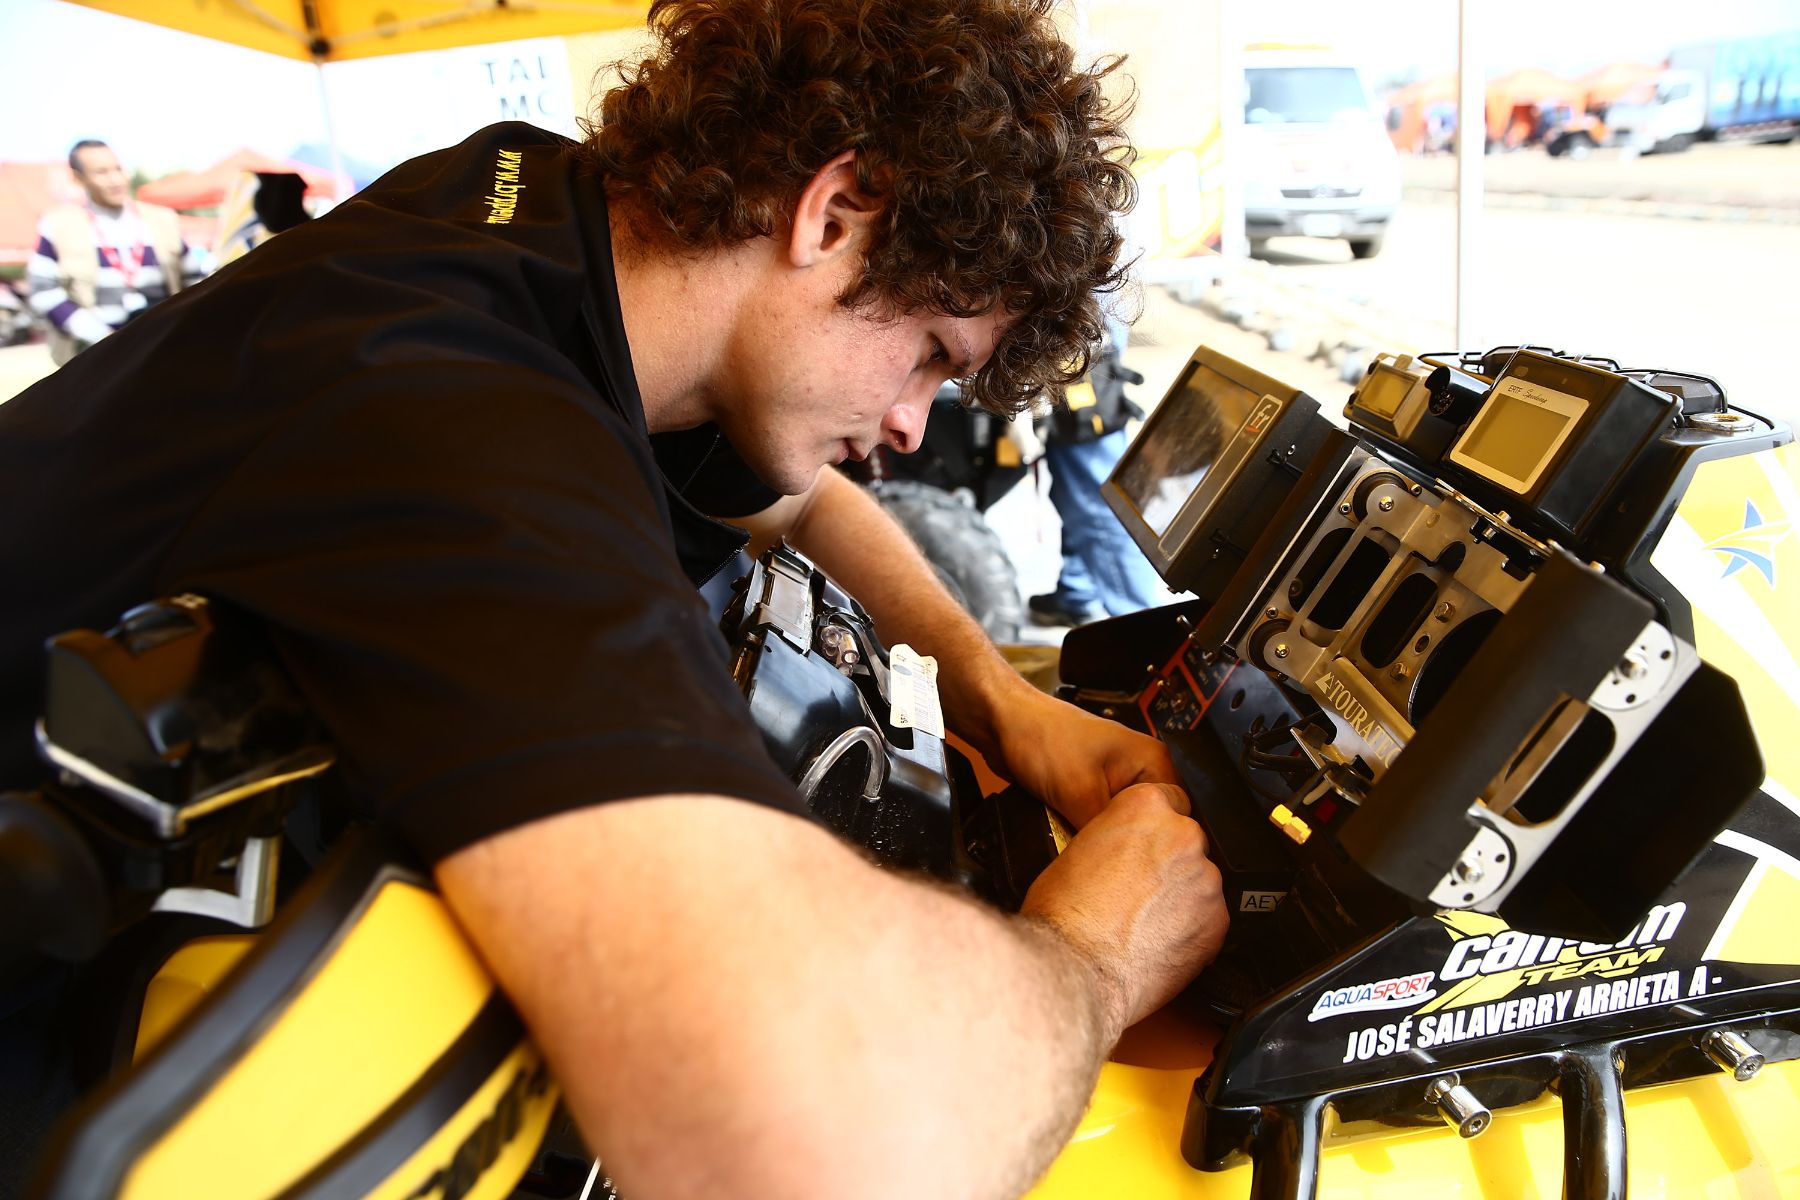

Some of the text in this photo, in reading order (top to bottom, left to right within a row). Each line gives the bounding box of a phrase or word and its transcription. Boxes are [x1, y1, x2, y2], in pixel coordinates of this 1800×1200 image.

[1524, 946, 1666, 986] TEAM
[1317, 975, 1432, 1010] AQUASPORT
[1342, 1014, 1413, 1064] JOSÉ
[1416, 989, 1573, 1049] SALAVERRY
[1572, 970, 1680, 1019] ARRIETA
